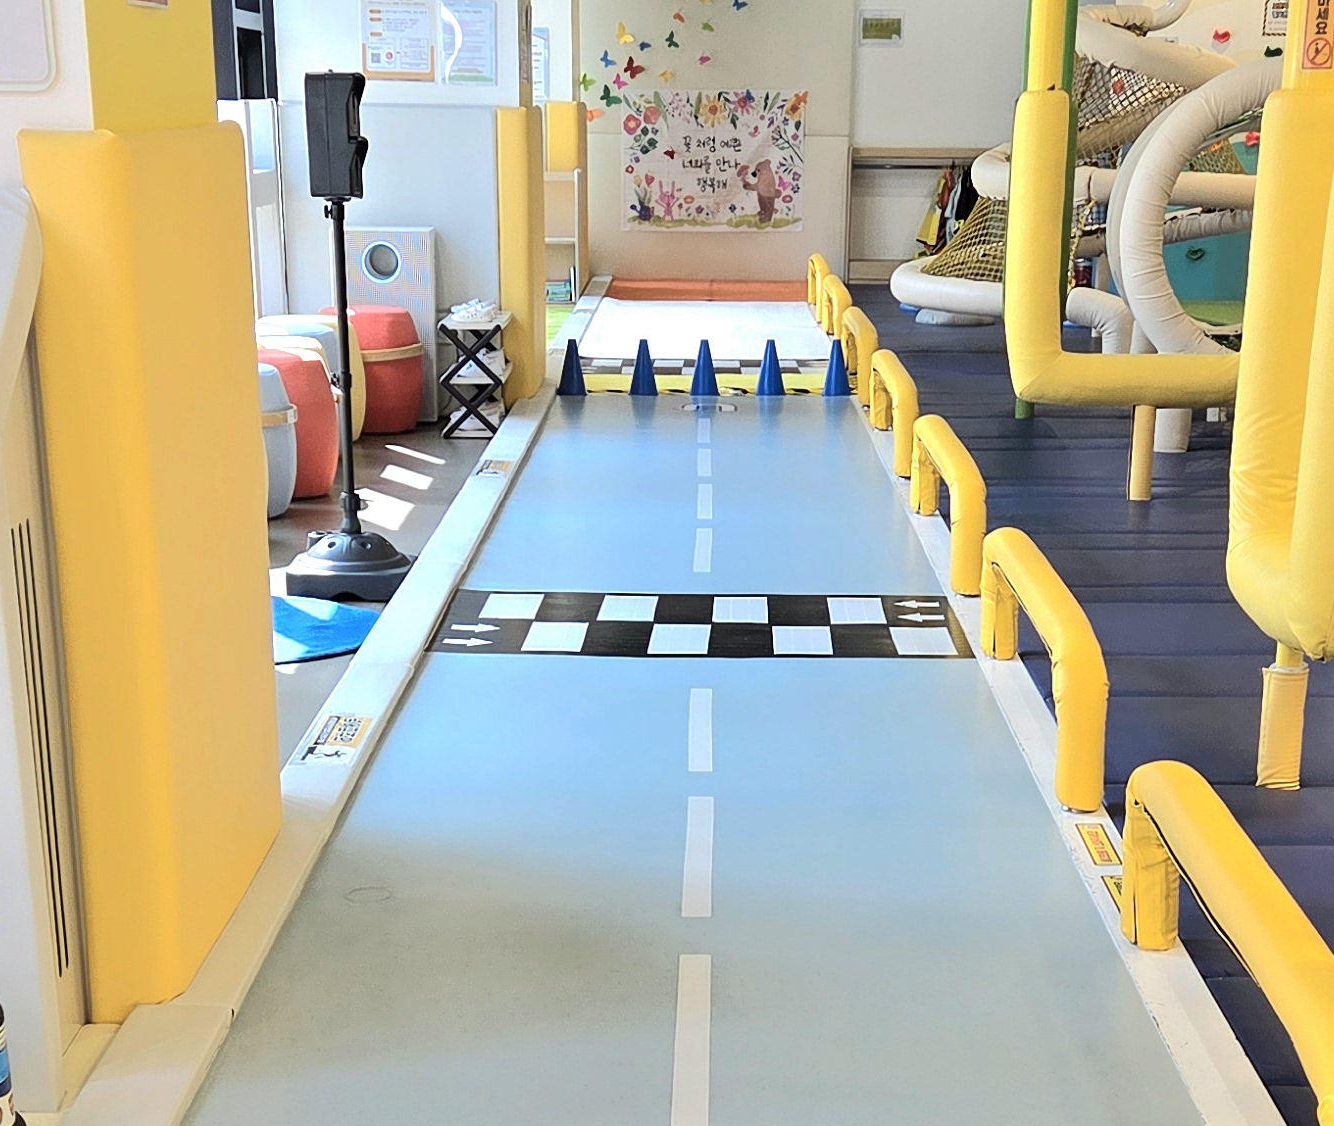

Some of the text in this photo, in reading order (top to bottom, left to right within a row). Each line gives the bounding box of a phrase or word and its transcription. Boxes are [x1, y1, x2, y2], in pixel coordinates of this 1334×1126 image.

[683, 135, 692, 153] 꽃
[696, 136, 716, 152] 처럼
[682, 155, 711, 174] 너희를
[697, 177, 728, 193] 행복해
